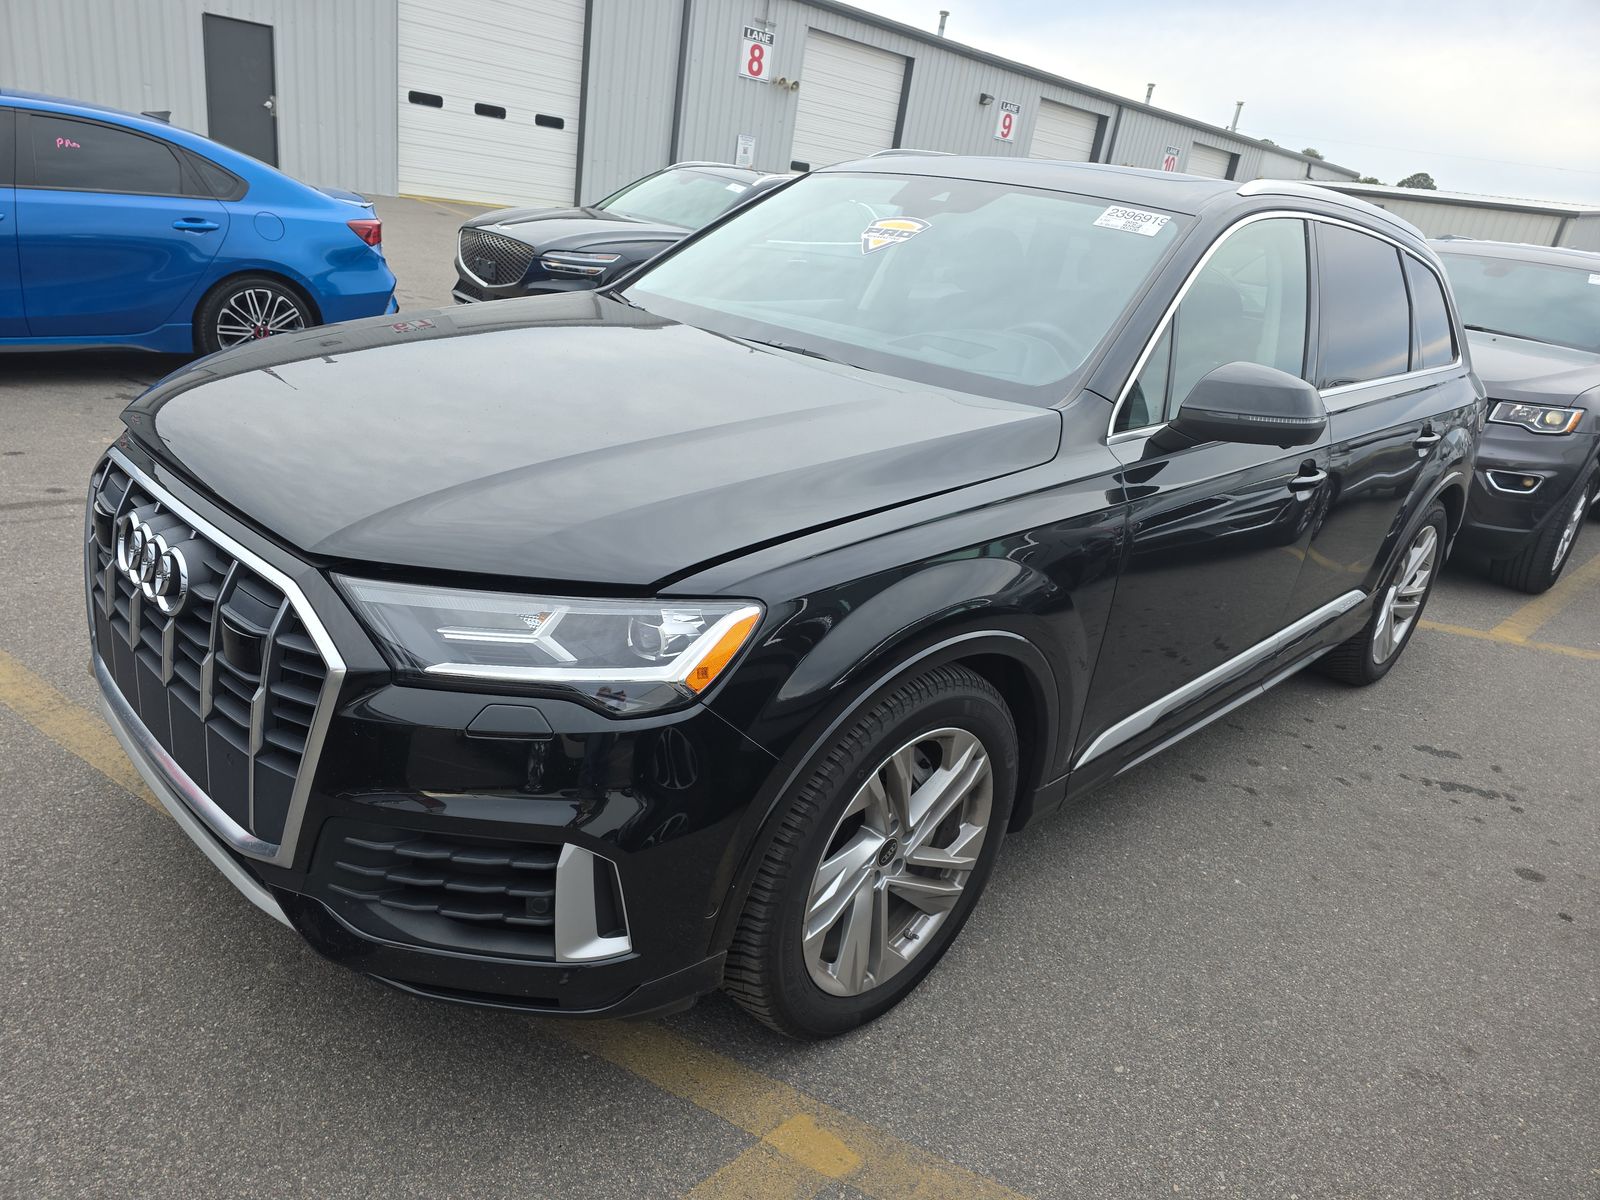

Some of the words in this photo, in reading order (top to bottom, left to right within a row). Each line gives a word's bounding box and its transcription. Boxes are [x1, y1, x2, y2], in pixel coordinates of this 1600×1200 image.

[747, 29, 771, 43] LANE
[748, 44, 764, 76] 8
[1002, 102, 1018, 113] LANE
[1001, 113, 1012, 138] 9
[1164, 155, 1175, 171] 10
